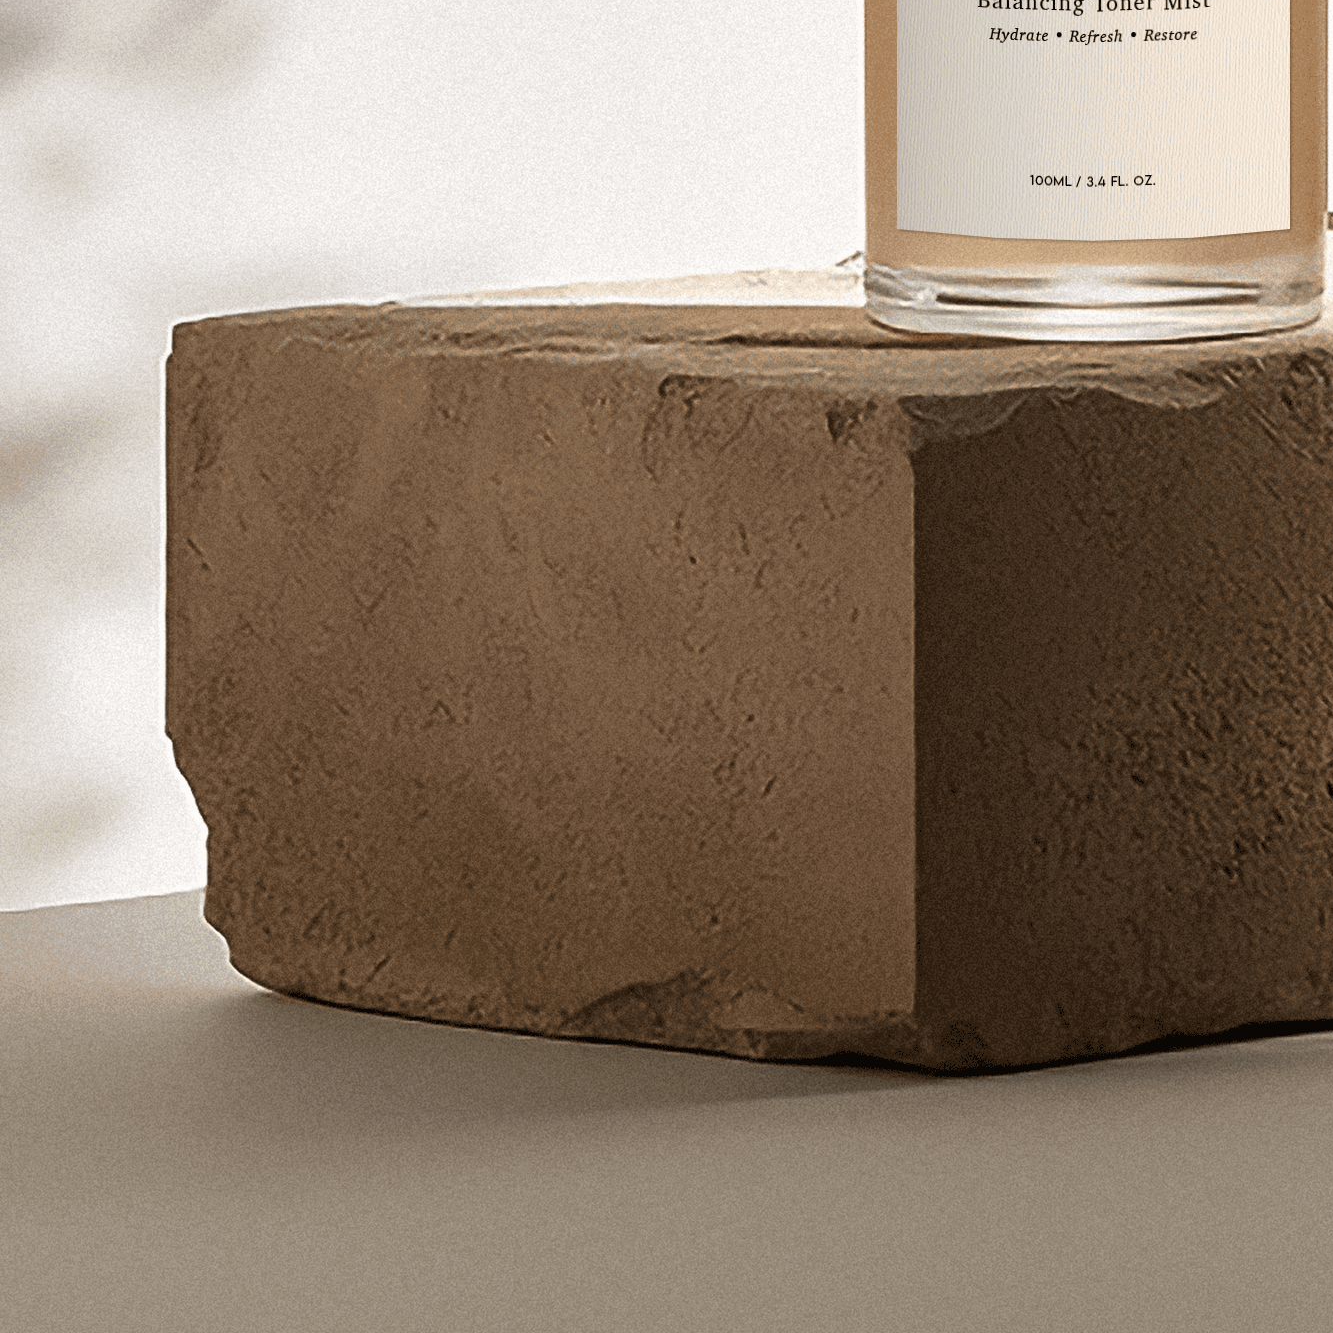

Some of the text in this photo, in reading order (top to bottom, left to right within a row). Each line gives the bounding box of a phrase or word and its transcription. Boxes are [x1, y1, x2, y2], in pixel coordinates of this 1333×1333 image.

[988, 27, 1198, 46] Hydrate Refresh Restore
[1029, 174, 1073, 187] 100ML
[1086, 175, 1106, 188] 3.4
[1110, 175, 1129, 187] FL.
[1133, 174, 1156, 186] OZ.
